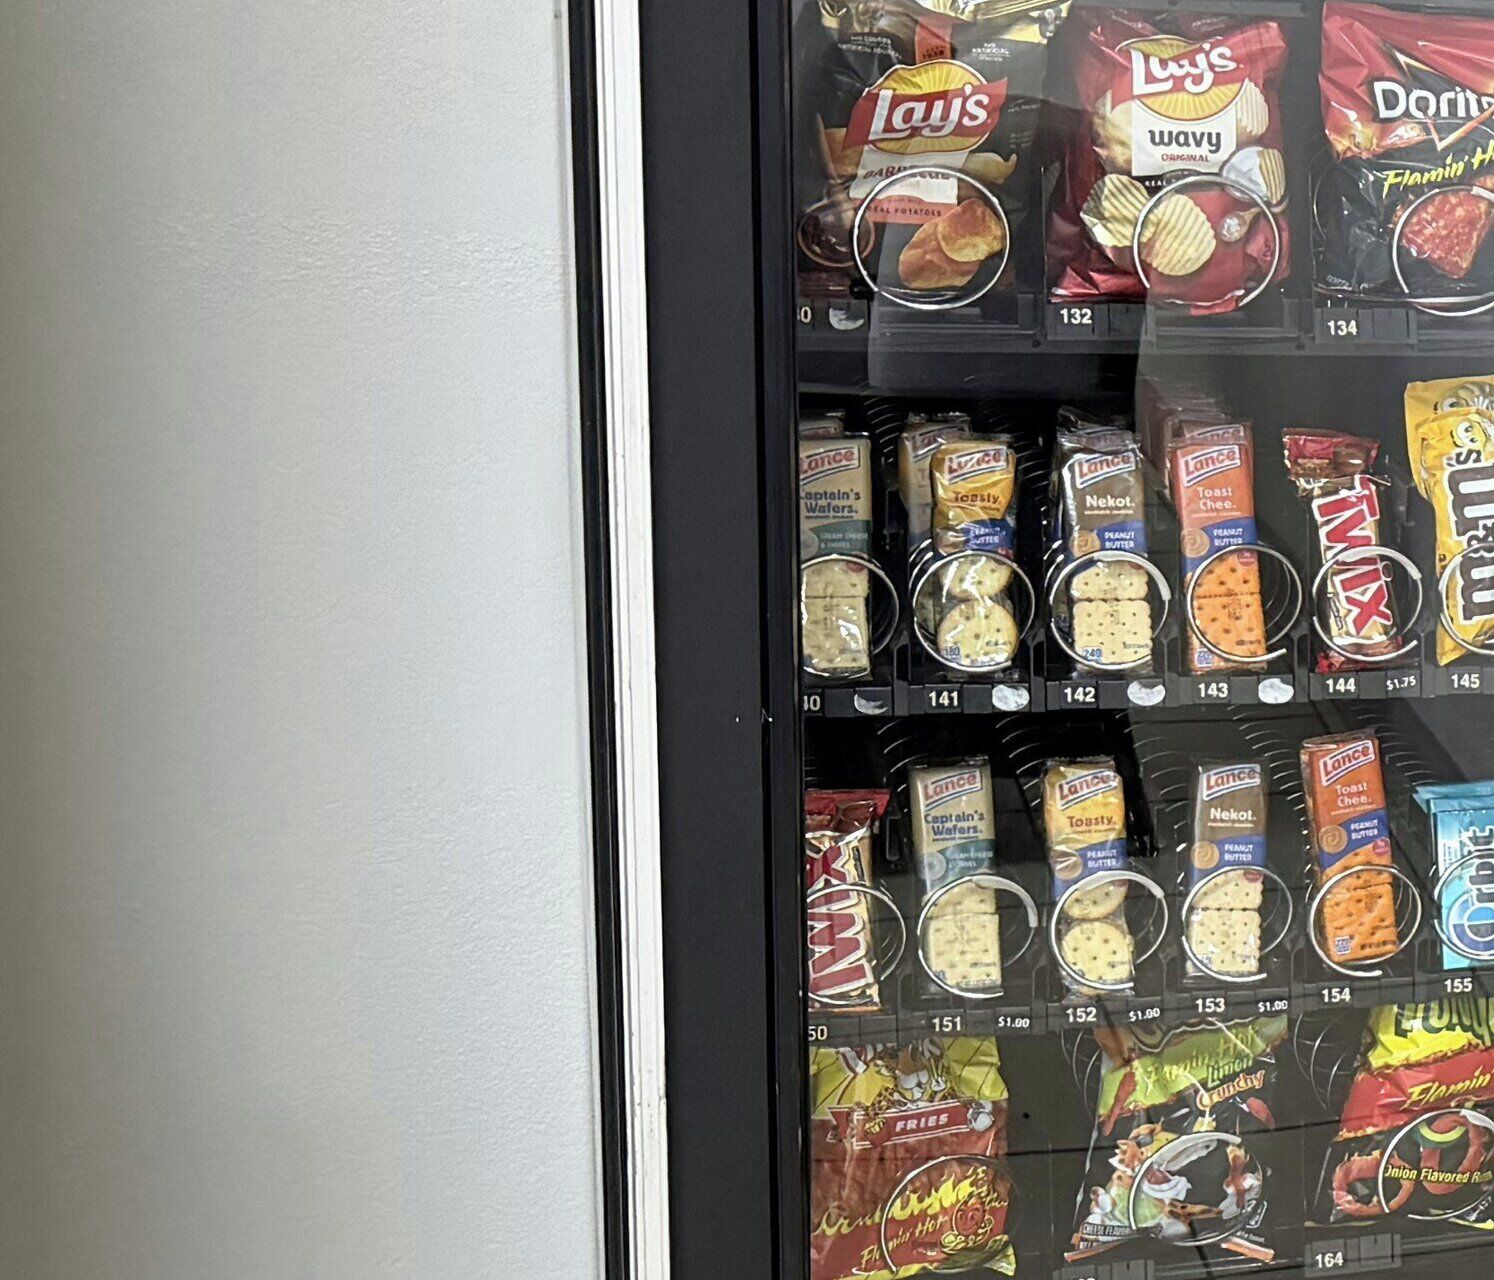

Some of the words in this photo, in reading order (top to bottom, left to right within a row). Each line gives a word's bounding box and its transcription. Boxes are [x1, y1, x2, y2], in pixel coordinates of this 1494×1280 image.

[868, 82, 990, 142] Lay's
[1147, 128, 1222, 154] wavy
[1161, 153, 1211, 164] ORIGINAL
[1381, 152, 1469, 200] Flamin'
[1060, 308, 1093, 325] 132
[1327, 320, 1358, 337] 134
[1078, 452, 1134, 478] Lance
[1184, 446, 1237, 476] Lance
[1198, 486, 1233, 498] Toast
[1104, 530, 1135, 541] PEANUT
[1213, 528, 1243, 538] PEANUT
[1104, 540, 1135, 550] BUTTER
[1213, 536, 1243, 547] BUTTER
[1198, 682, 1229, 697] 143
[1325, 676, 1356, 693] 144
[1386, 675, 1417, 691] $1.75
[1450, 674, 1481, 690] 145
[928, 690, 959, 707] 141
[1063, 686, 1096, 704] 142
[1322, 744, 1372, 778] Lance
[924, 772, 978, 802] Lance
[1059, 769, 1117, 801] Lance
[1205, 766, 1260, 793] Lance
[1335, 781, 1368, 793] Toast
[924, 810, 986, 826] Captain's
[1350, 819, 1378, 831] PEANUT
[1350, 828, 1378, 840] BUTTER
[1086, 848, 1117, 859] PEANUT
[1224, 843, 1253, 854] PEANUT
[1087, 858, 1117, 870] BUTTER
[1224, 852, 1253, 863] BUTTER
[1444, 978, 1473, 993] 155
[1321, 987, 1351, 1003] 154
[1195, 997, 1226, 1013] 153
[1257, 1000, 1288, 1012] $1.00
[1065, 1007, 1098, 1023] 152
[1128, 1007, 1161, 1022] $1.00
[931, 1016, 962, 1032] 151
[998, 1017, 1030, 1029] $1.00
[1196, 1070, 1266, 1111] Crunchy
[1402, 1066, 1493, 1113] Flamin'
[895, 1113, 949, 1133] FRIES
[1385, 1163, 1418, 1181] Onion
[1420, 1167, 1470, 1184] Flavored
[1314, 1252, 1344, 1268] 164
